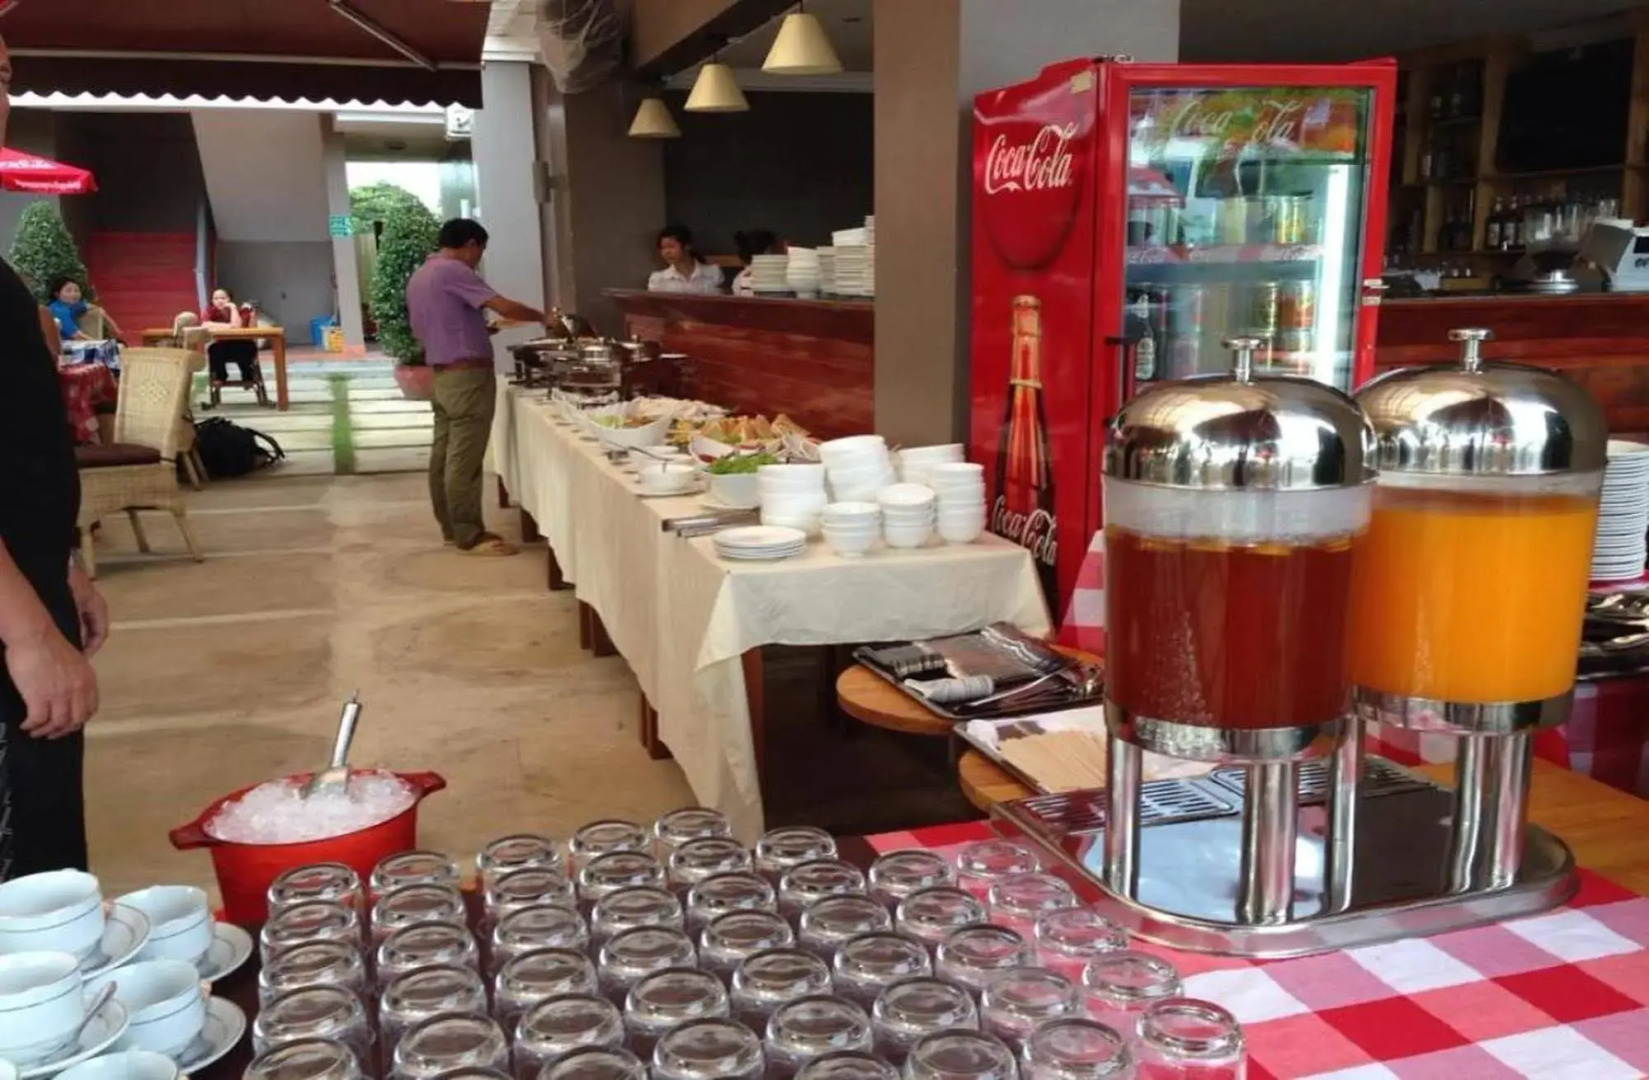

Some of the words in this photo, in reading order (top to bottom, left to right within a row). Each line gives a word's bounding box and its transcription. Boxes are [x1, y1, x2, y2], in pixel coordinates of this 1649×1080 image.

[984, 121, 1080, 194] Coca-Cola
[1170, 98, 1304, 146] Cocaola
[992, 494, 1059, 567] Coca-Cola
